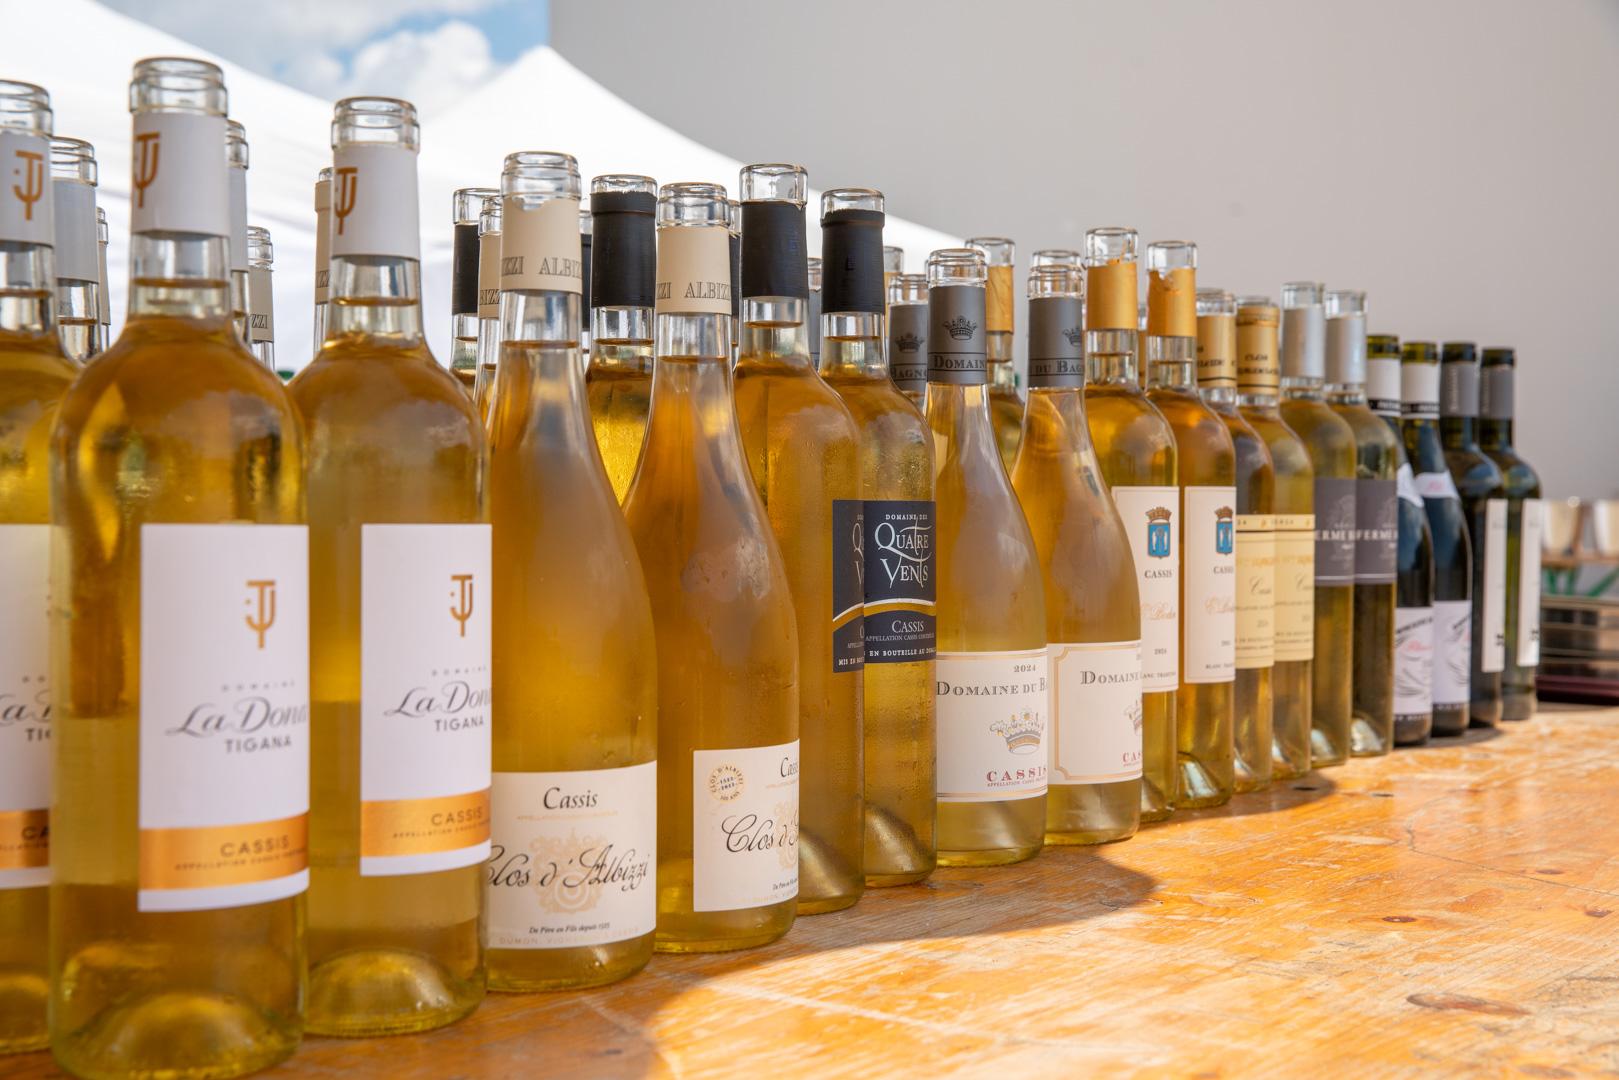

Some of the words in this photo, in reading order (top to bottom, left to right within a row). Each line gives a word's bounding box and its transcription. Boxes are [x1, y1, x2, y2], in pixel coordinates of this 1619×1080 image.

[874, 519, 932, 562] QUATRE
[879, 550, 930, 589] VENTS
[892, 619, 925, 633] CASSIS
[937, 682, 1019, 696] DOMAINE
[1023, 683, 1037, 694] DU
[384, 687, 436, 718] La
[165, 703, 226, 738] La
[224, 737, 292, 754] TIGANA
[543, 786, 600, 810] Cassis
[431, 806, 483, 827] CASSIS
[721, 813, 775, 853] Clos
[219, 835, 290, 858] CASSIS
